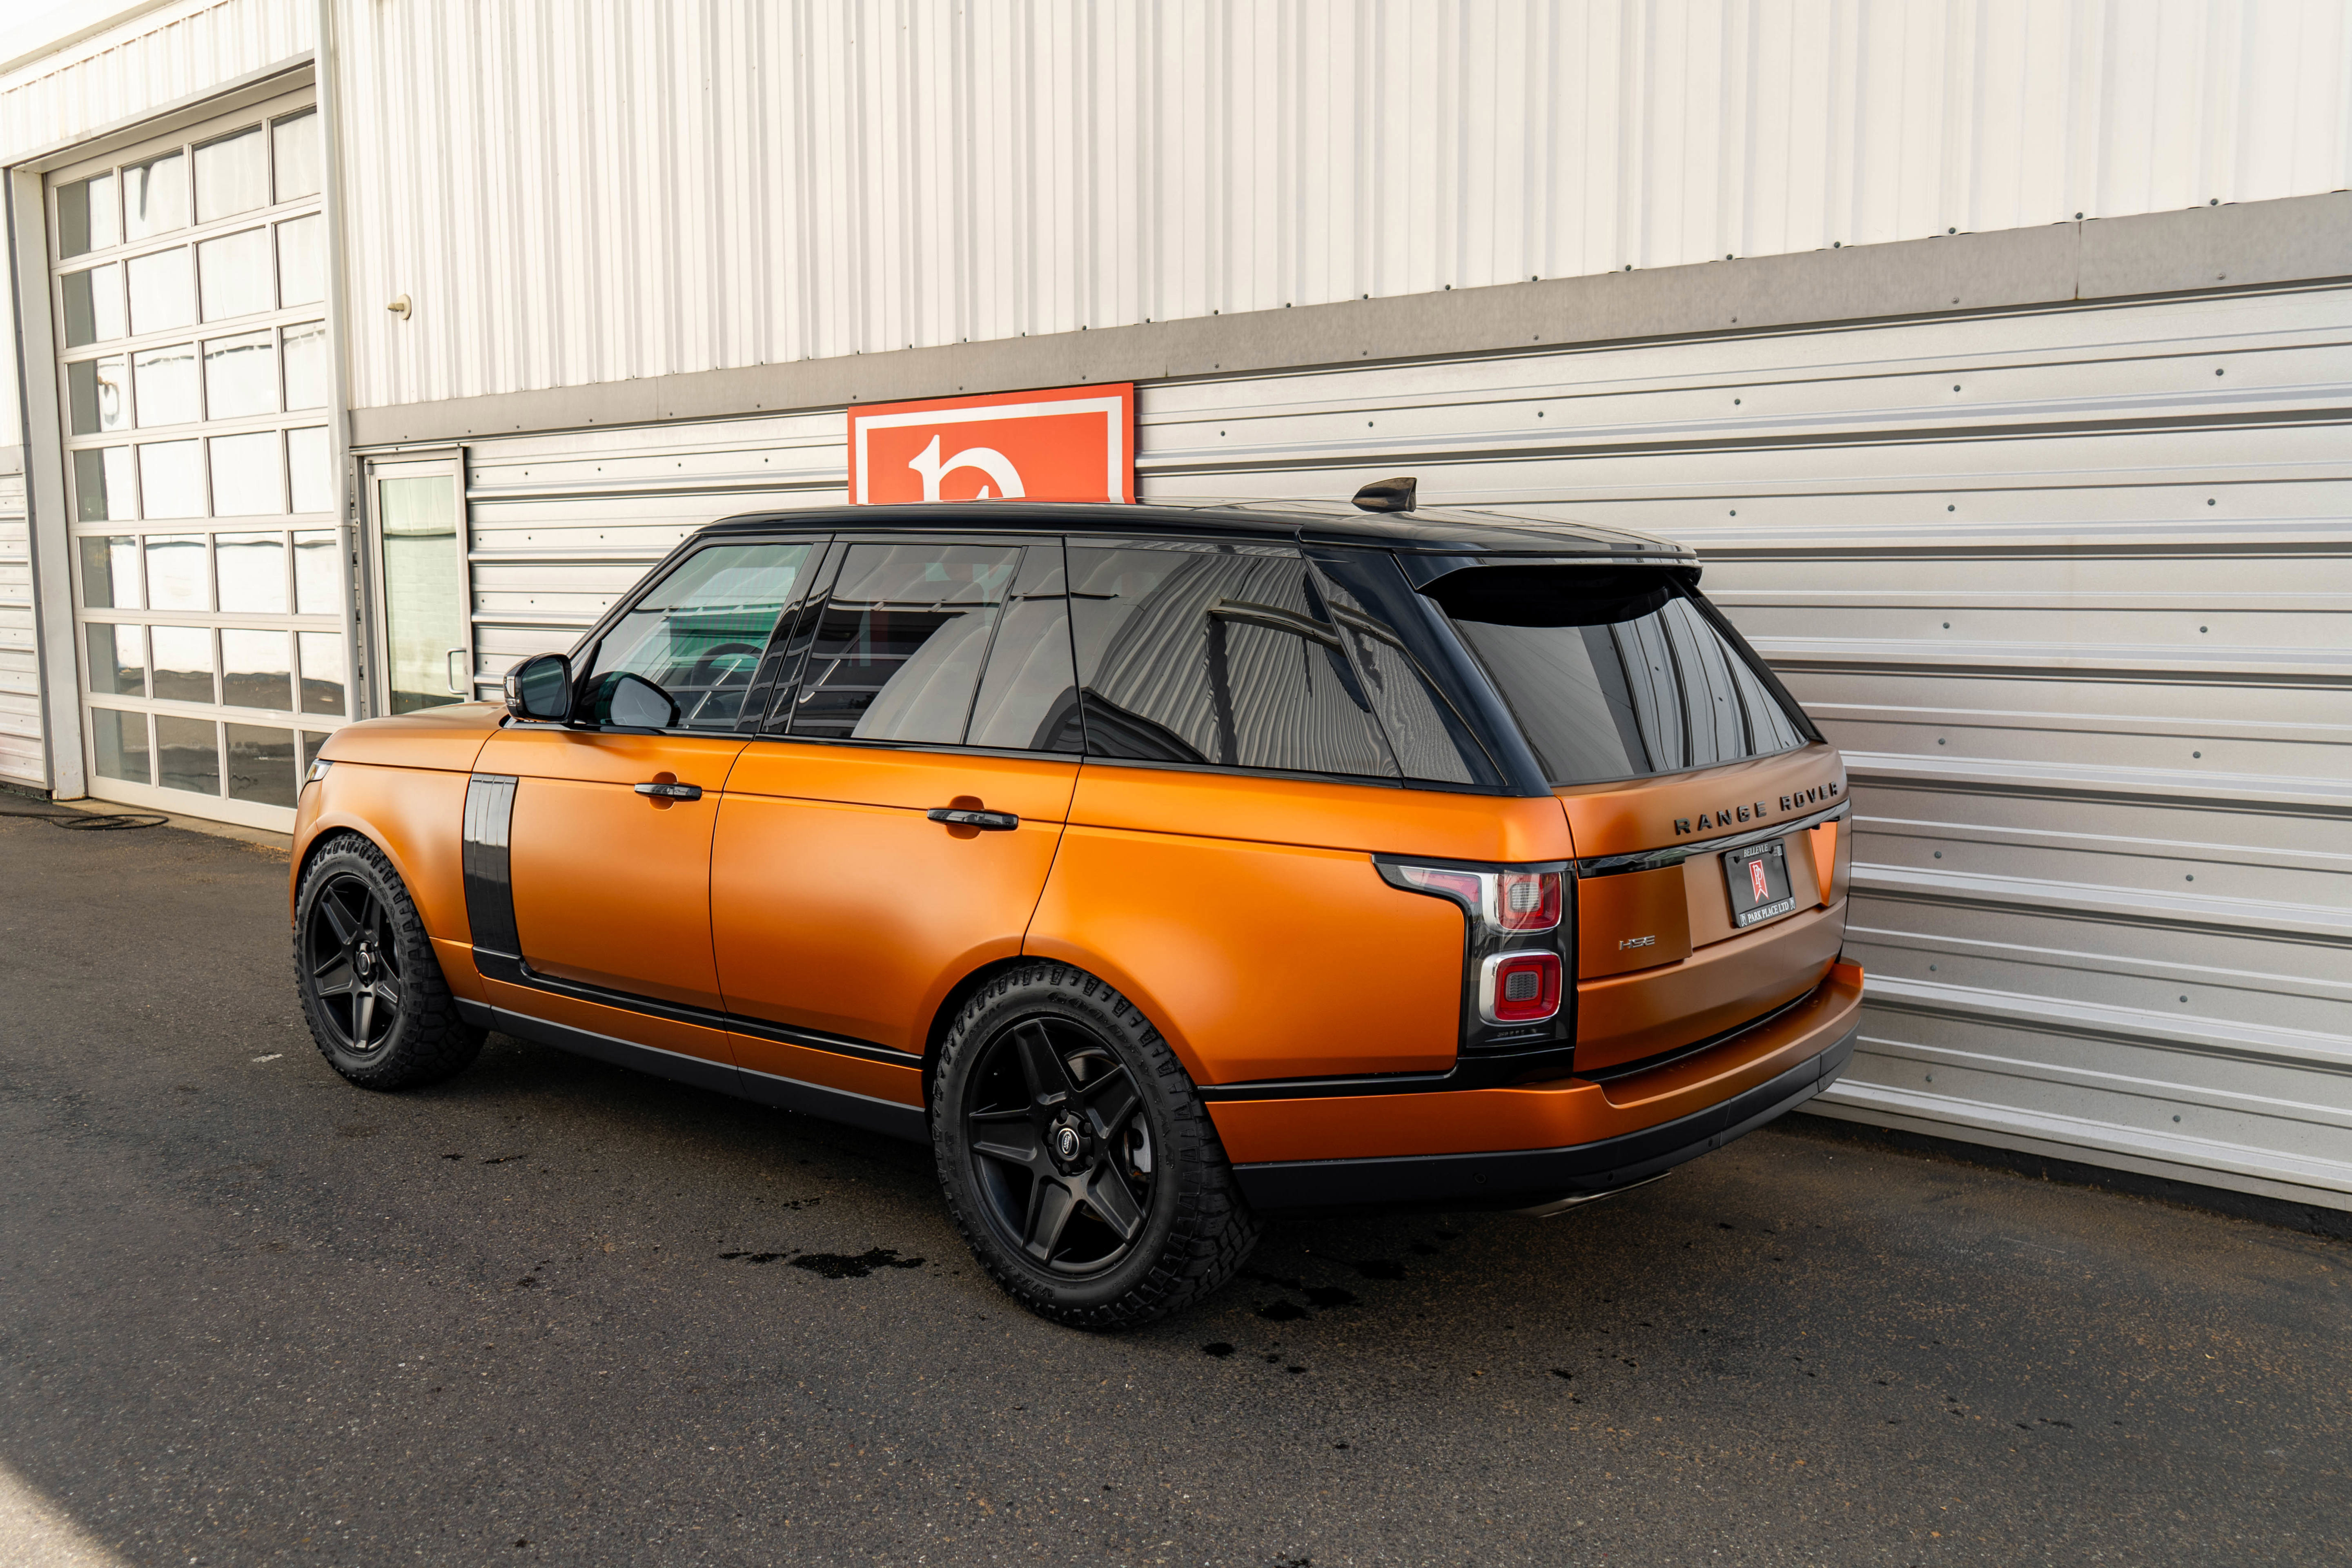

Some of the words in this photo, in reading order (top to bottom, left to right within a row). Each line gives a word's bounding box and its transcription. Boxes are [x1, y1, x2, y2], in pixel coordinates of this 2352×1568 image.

[1674, 800, 1767, 835] RANGE
[1780, 781, 1839, 812] ROVER
[1744, 844, 1768, 858] BELLEVUE
[1748, 911, 1762, 923] PARK
[1762, 905, 1779, 917] PLACE
[1779, 902, 1789, 913] LTD
[1619, 935, 1655, 951] HSE
[953, 1000, 1005, 1071] DURATRAC
[1047, 991, 1175, 1170] GOODYEAR
